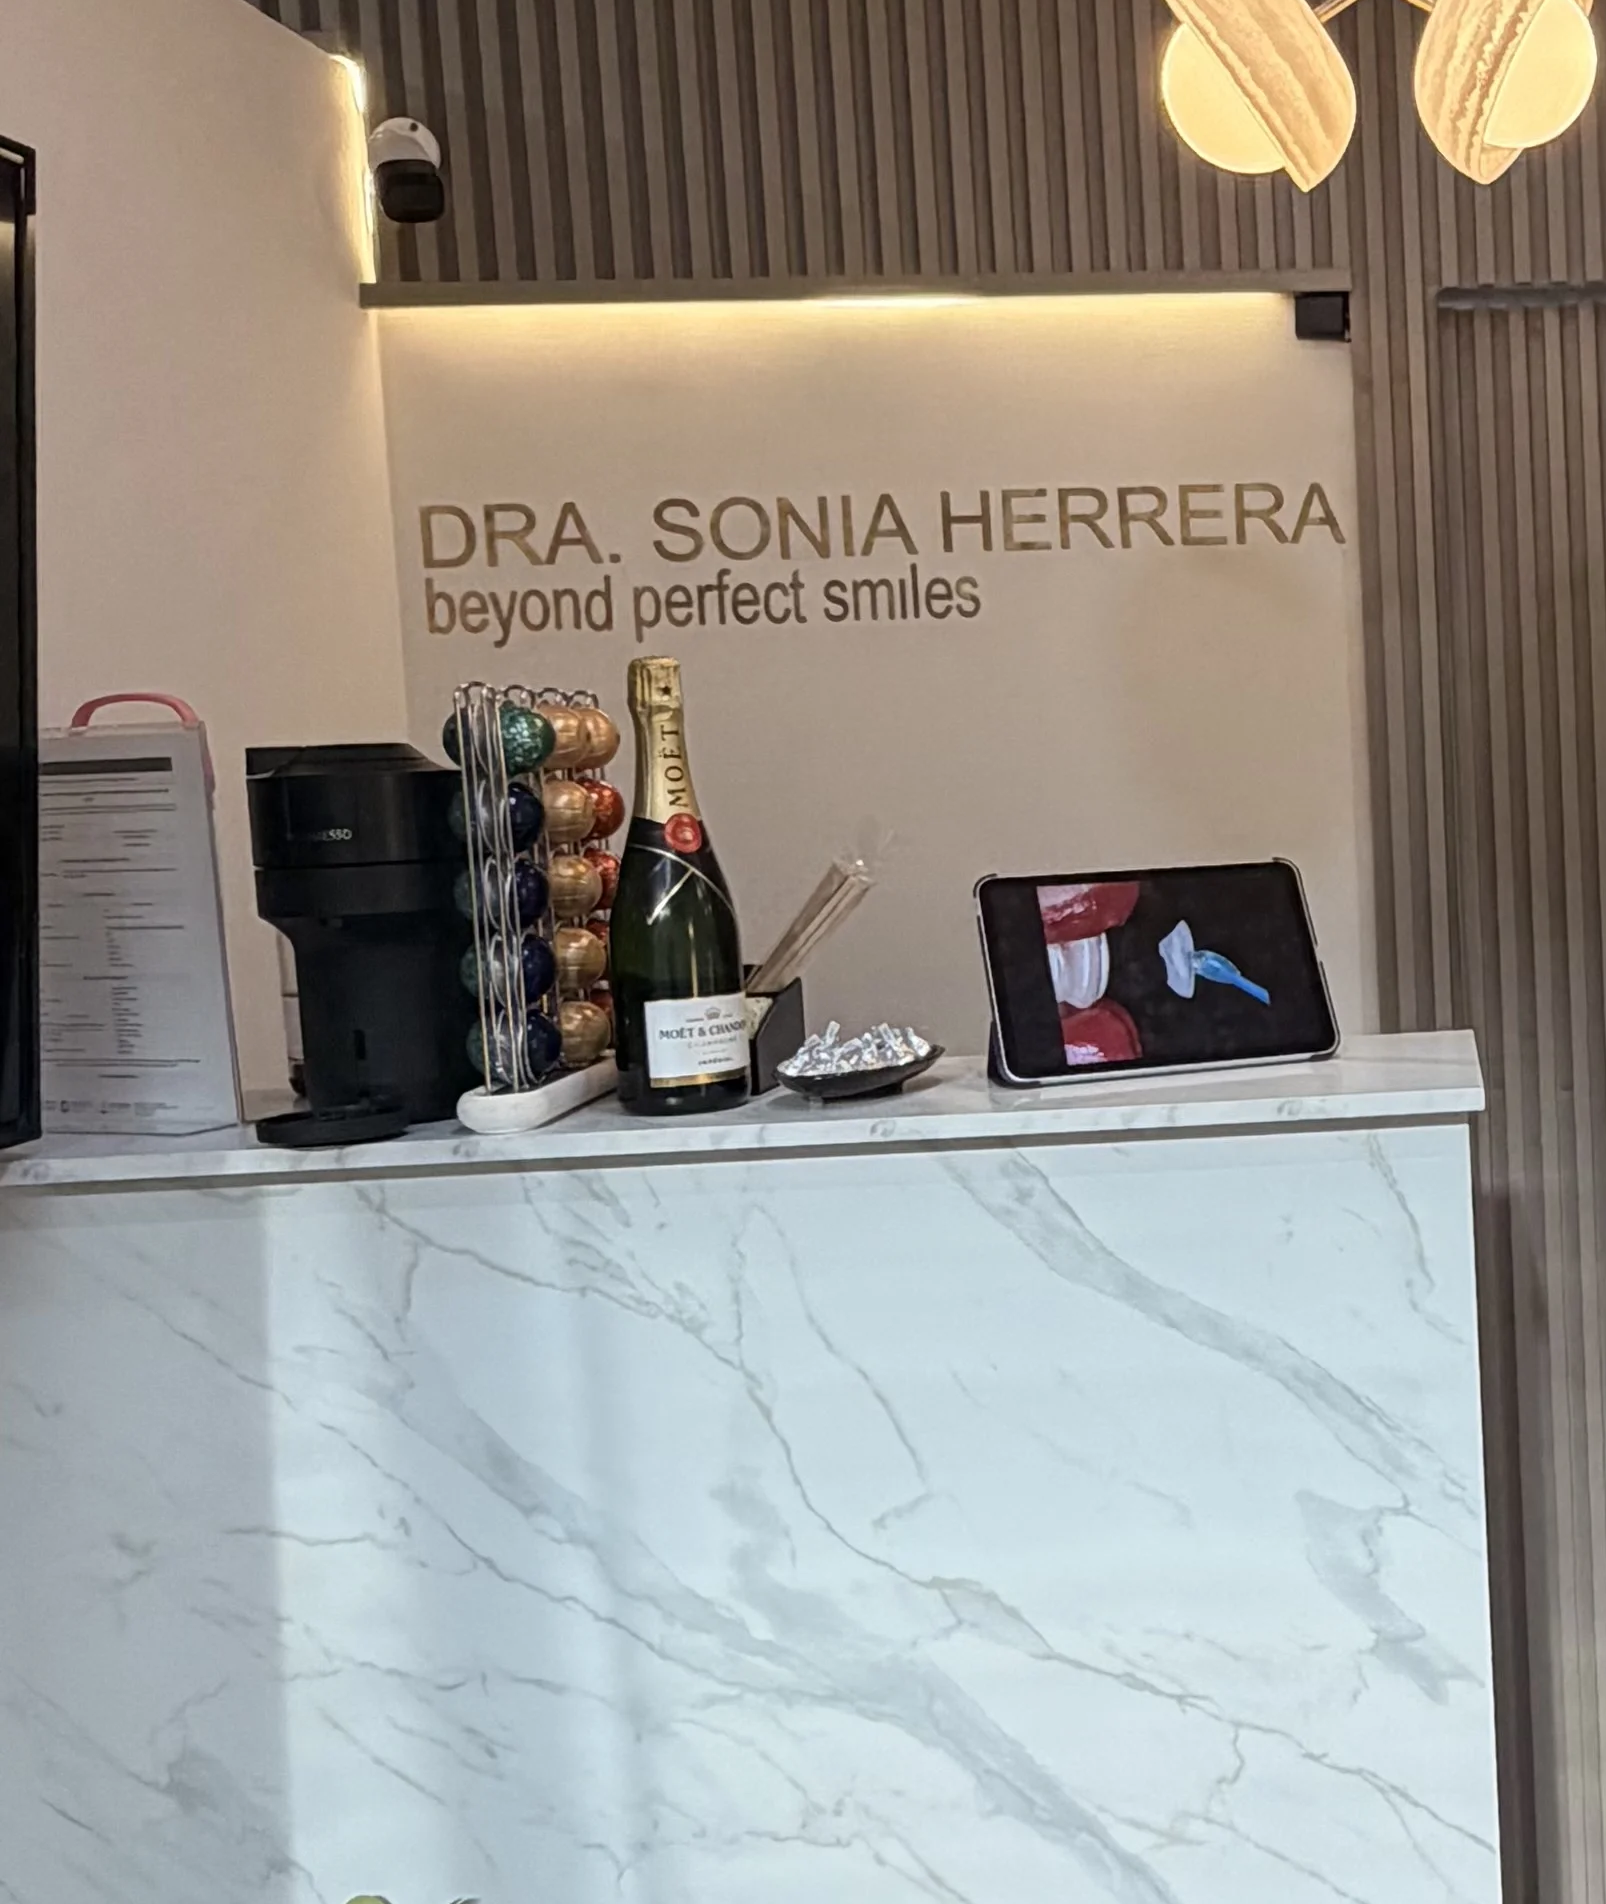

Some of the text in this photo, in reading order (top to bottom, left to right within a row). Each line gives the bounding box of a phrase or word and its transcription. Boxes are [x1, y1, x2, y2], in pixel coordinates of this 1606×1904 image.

[418, 482, 1347, 569] DRA. SONIA HERRERA
[424, 562, 982, 648] beyond perfect smiles
[659, 725, 689, 808] MOËT
